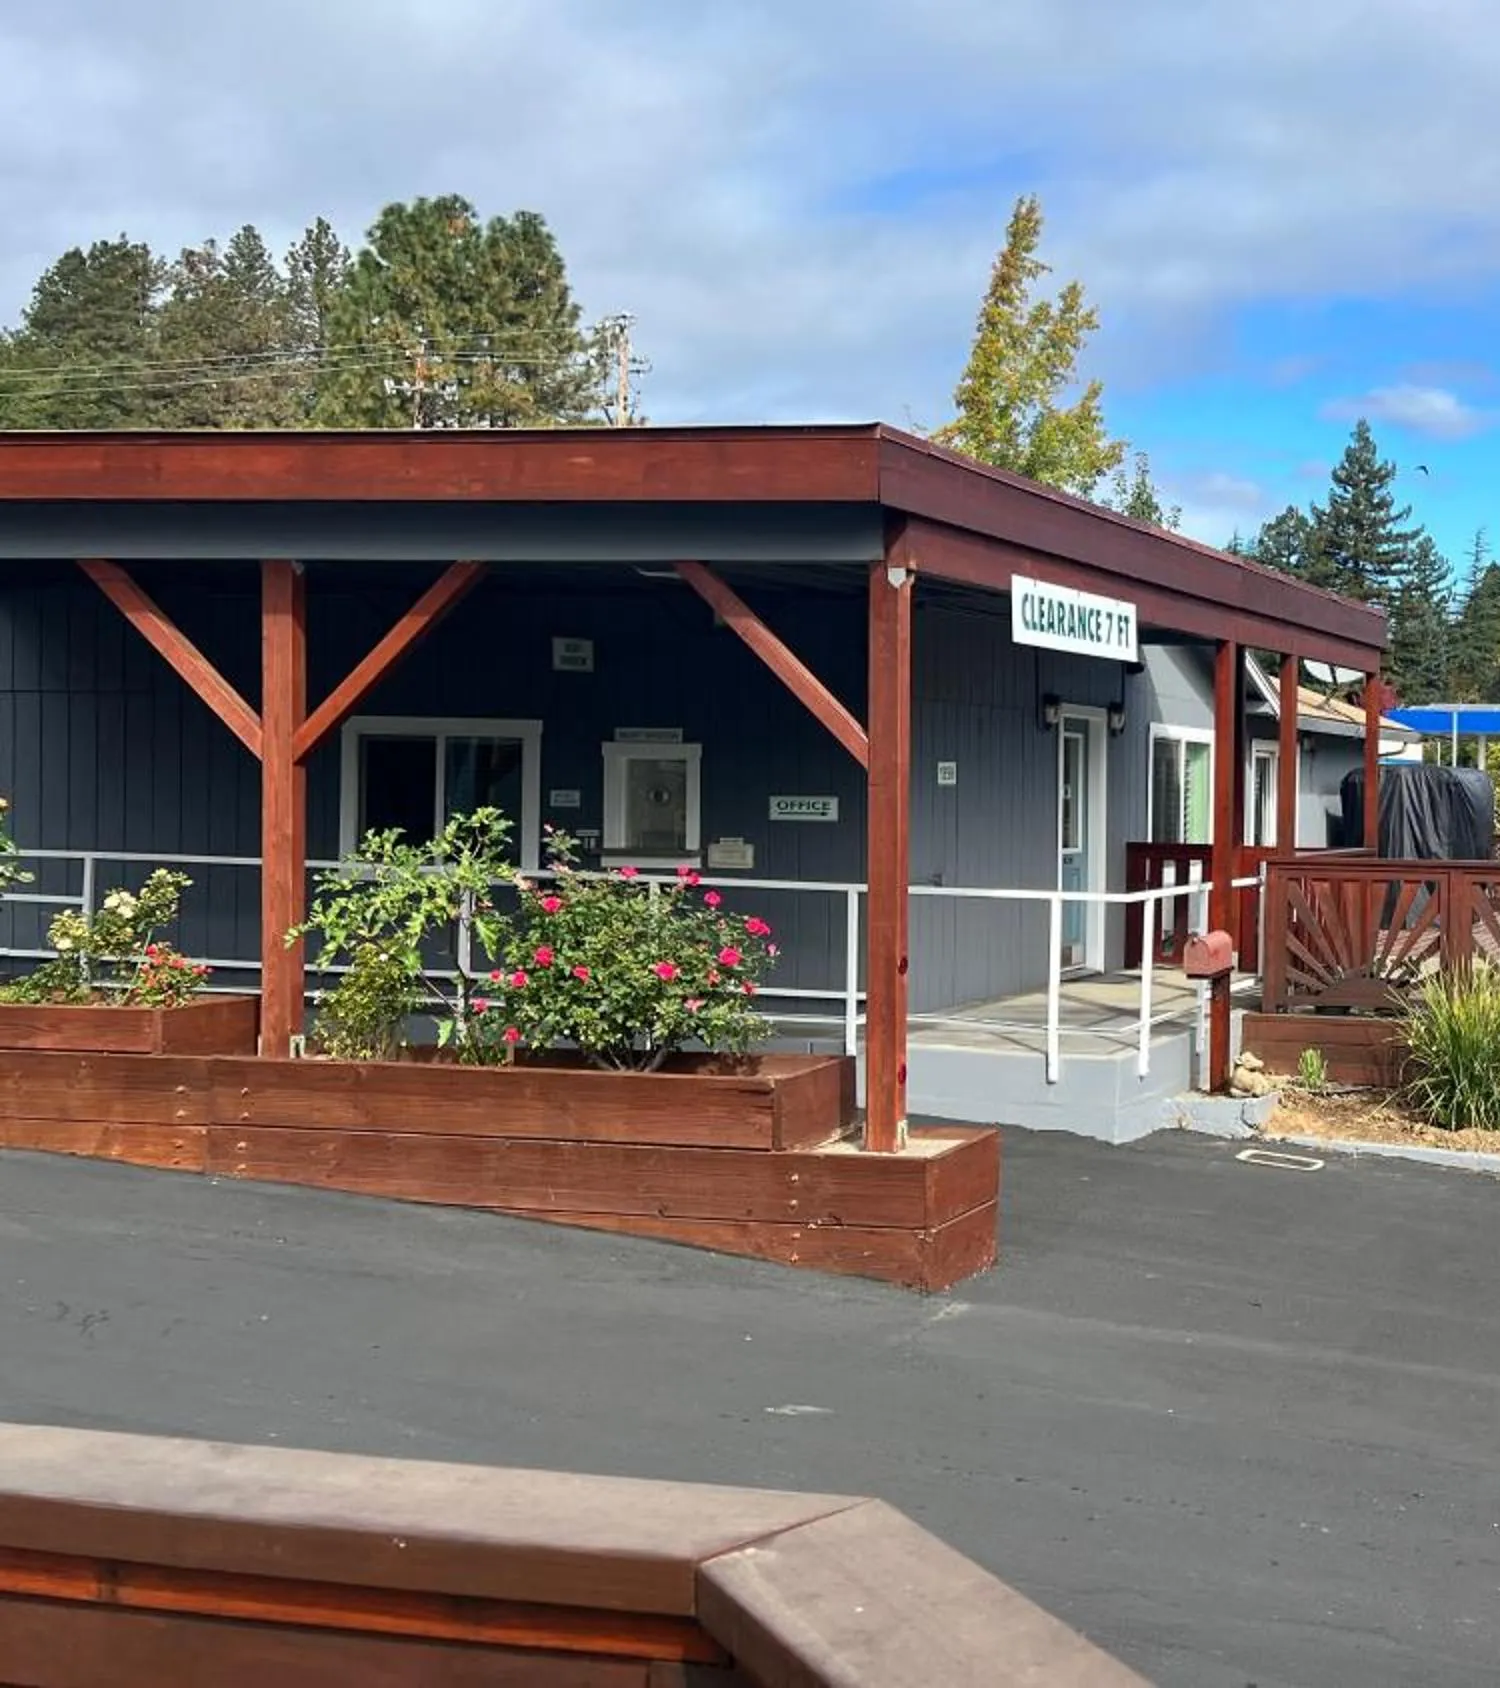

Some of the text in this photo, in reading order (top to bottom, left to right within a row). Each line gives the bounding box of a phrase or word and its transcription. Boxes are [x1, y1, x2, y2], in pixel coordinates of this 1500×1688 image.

[1021, 592, 1130, 648] CLEARANCE 7 FT
[777, 800, 832, 811] OFFICE
